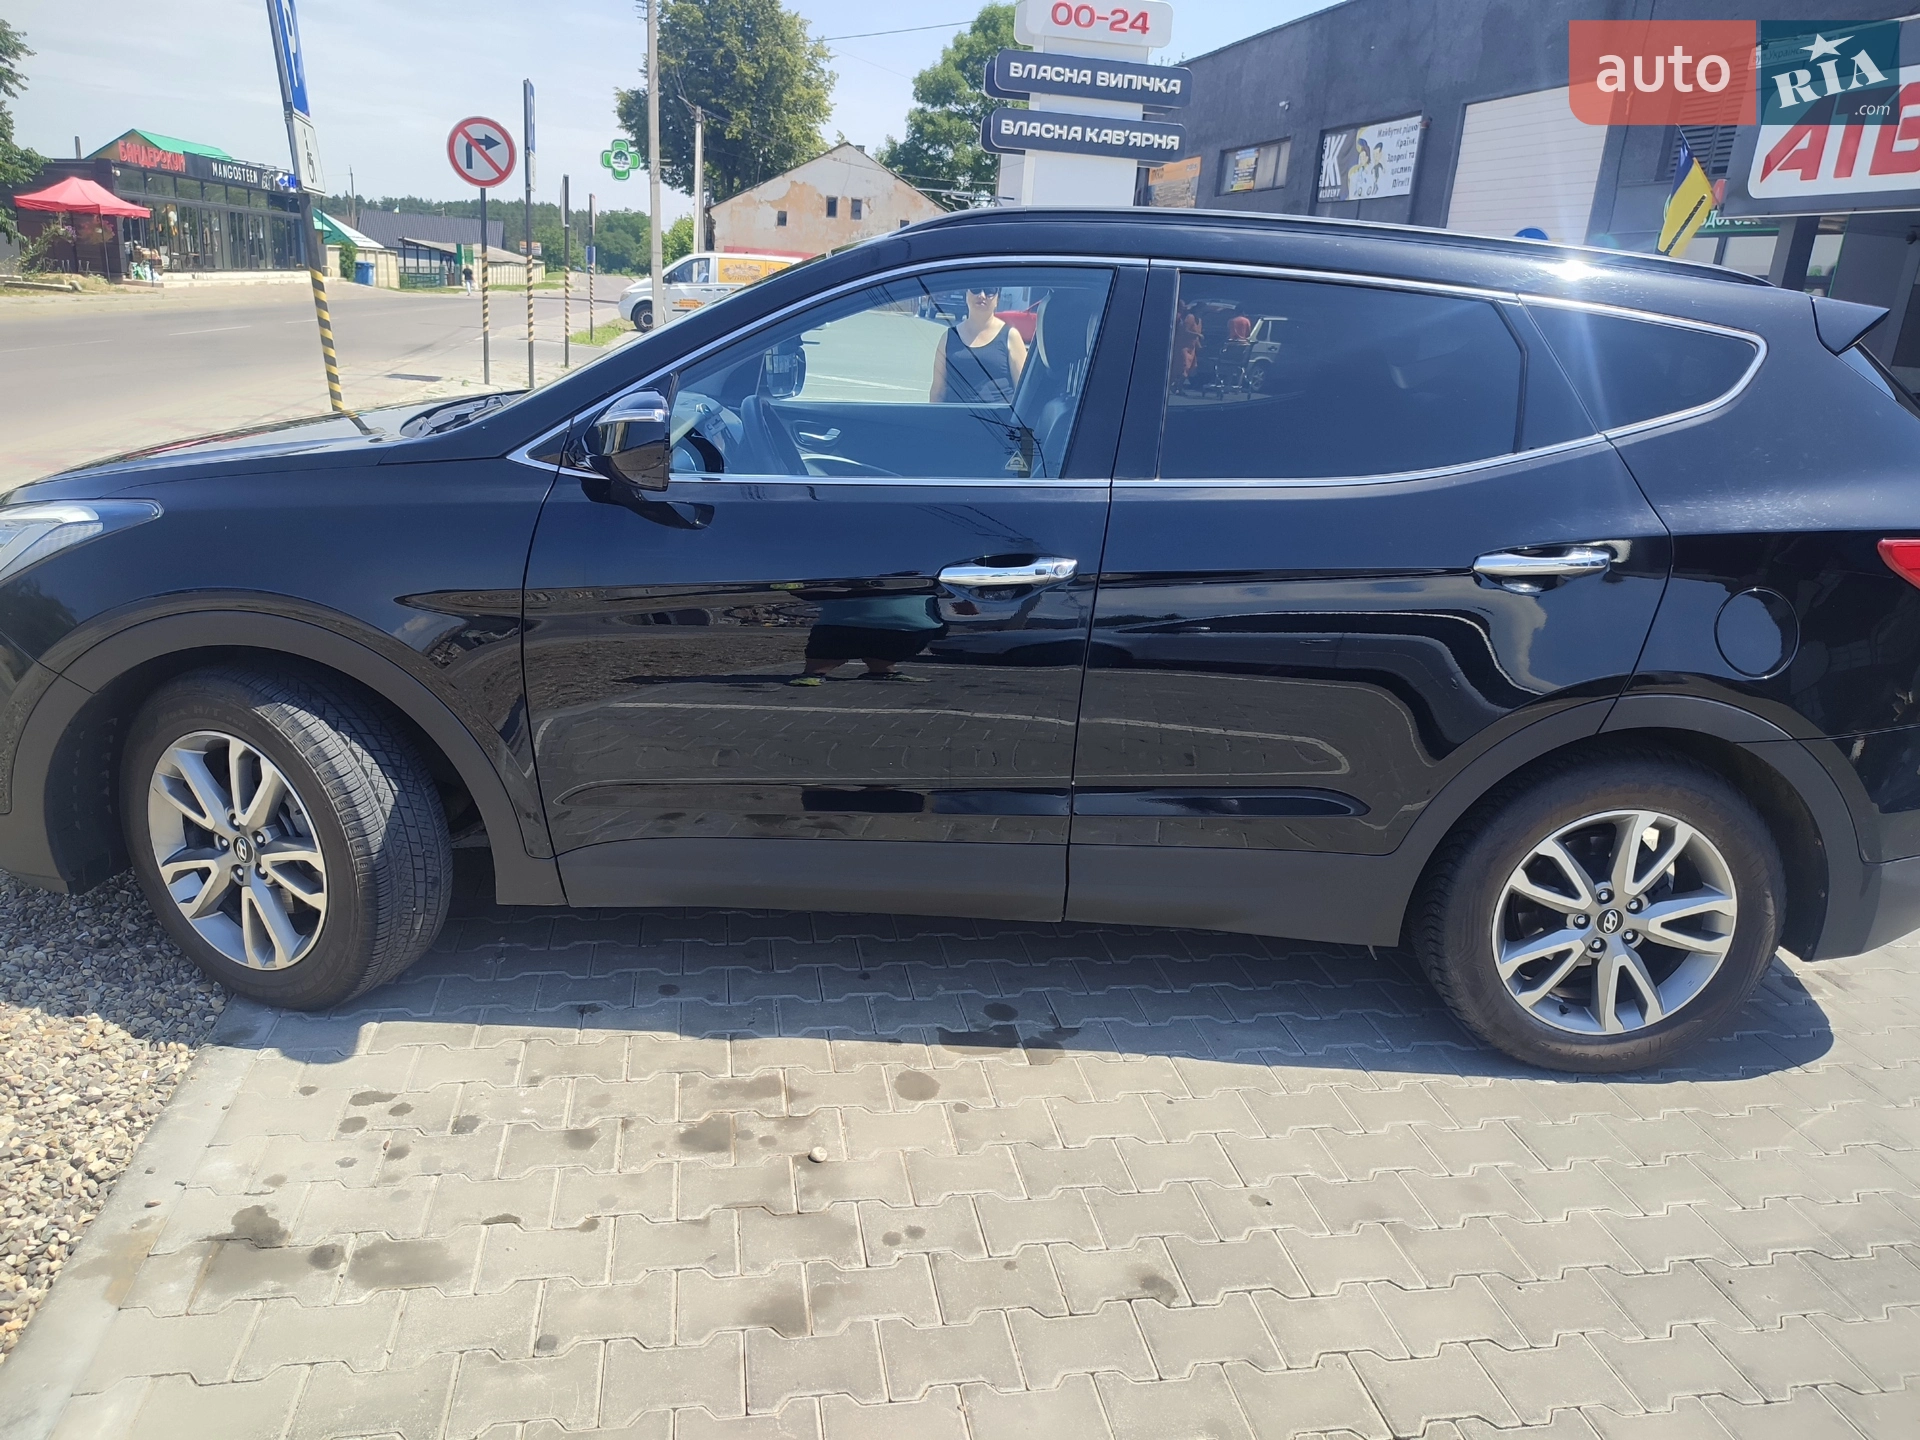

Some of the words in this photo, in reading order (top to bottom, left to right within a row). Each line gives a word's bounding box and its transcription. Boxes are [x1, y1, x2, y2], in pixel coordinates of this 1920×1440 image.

[1051, 2, 1150, 35] 00-24
[1009, 62, 1092, 85] ВЛАСНА
[1096, 71, 1182, 95] ВИПІЧКА
[1001, 119, 1082, 142] ВЛАСНА
[1085, 127, 1181, 151] КАВ'ЯРНЯ
[212, 162, 259, 184] MANGOSTEEN
